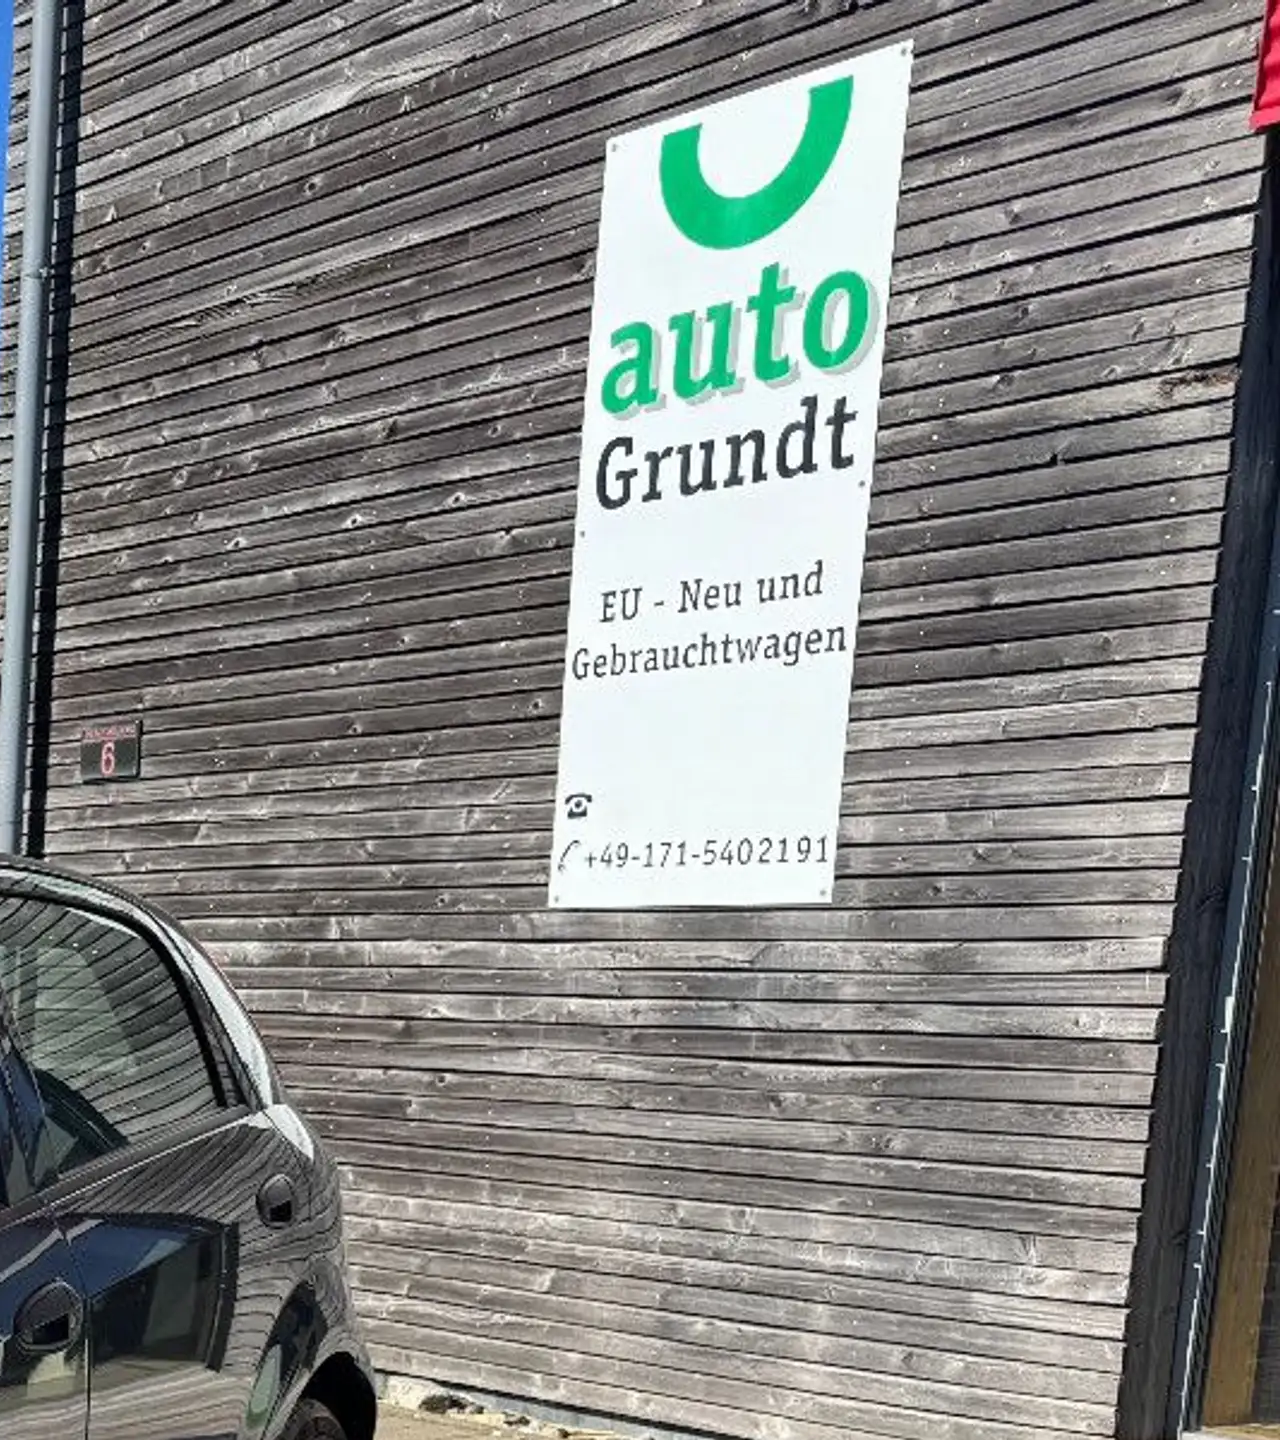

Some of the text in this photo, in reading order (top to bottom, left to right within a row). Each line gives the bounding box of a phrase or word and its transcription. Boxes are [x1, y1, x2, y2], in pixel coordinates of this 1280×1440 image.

[600, 262, 872, 418] auto
[596, 395, 858, 510] Grundt
[600, 587, 643, 623] EU
[677, 578, 743, 613] Neu
[757, 560, 824, 604] und
[571, 626, 847, 682] Gebrauchtwagen
[100, 740, 116, 776] 6
[584, 836, 829, 868] +49-171-5402191
